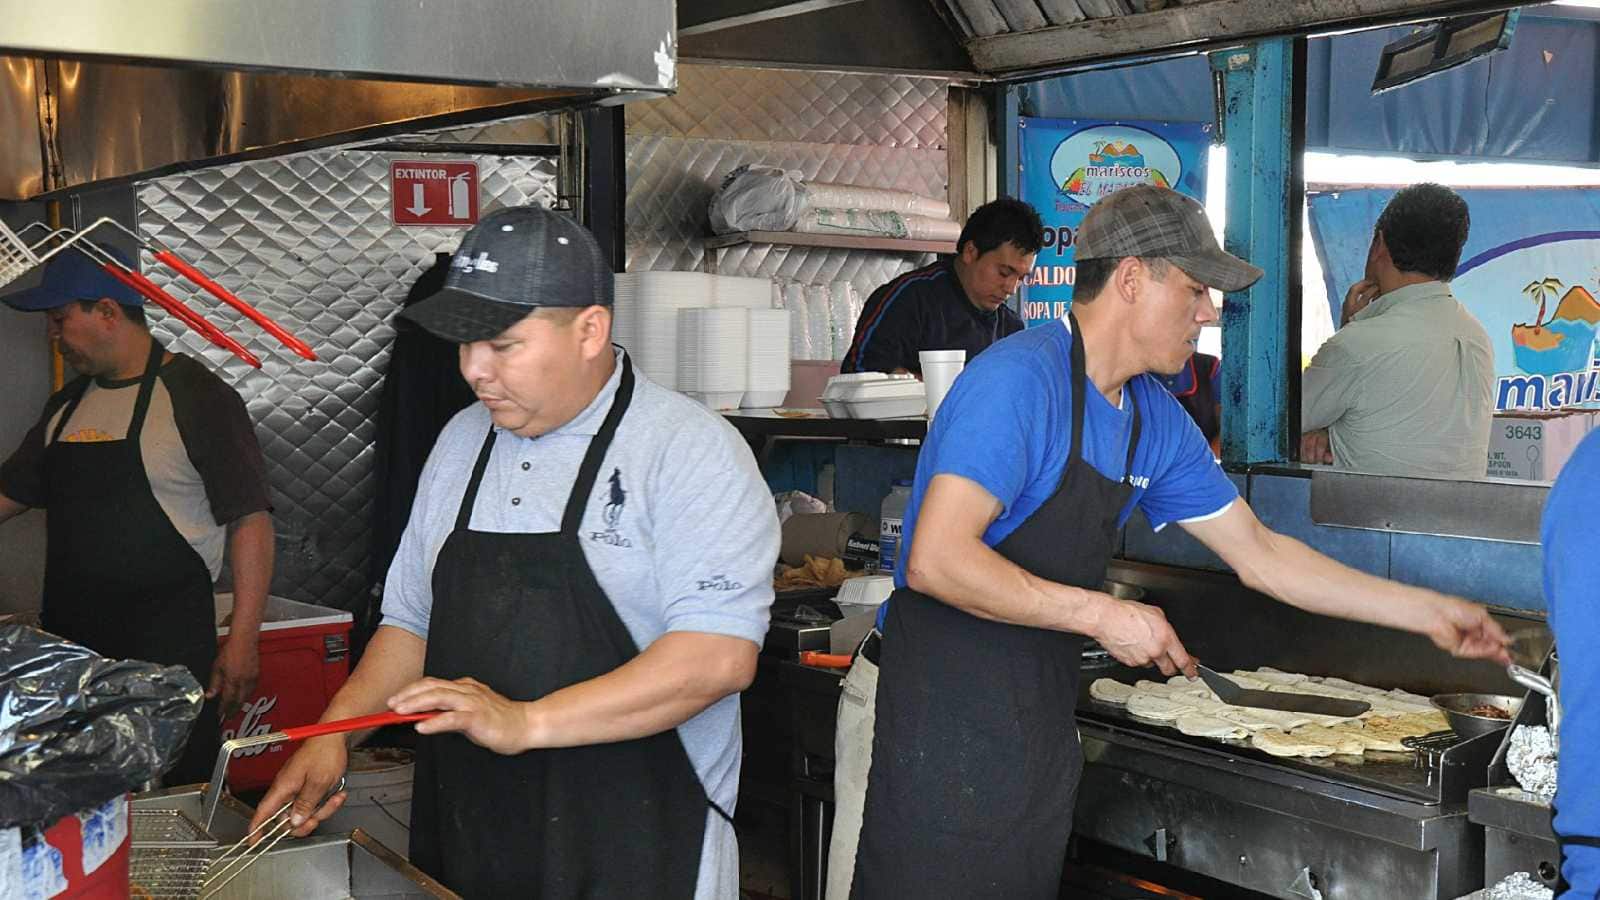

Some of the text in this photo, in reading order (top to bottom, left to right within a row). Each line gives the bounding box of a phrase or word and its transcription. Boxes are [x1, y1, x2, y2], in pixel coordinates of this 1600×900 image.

[395, 168, 447, 180] EXTINTOR
[1086, 163, 1150, 177] mariscos
[1024, 301, 1051, 320] SOPA
[1505, 425, 1542, 440] 3643
[590, 531, 633, 548] Polo
[696, 580, 745, 591] Polo
